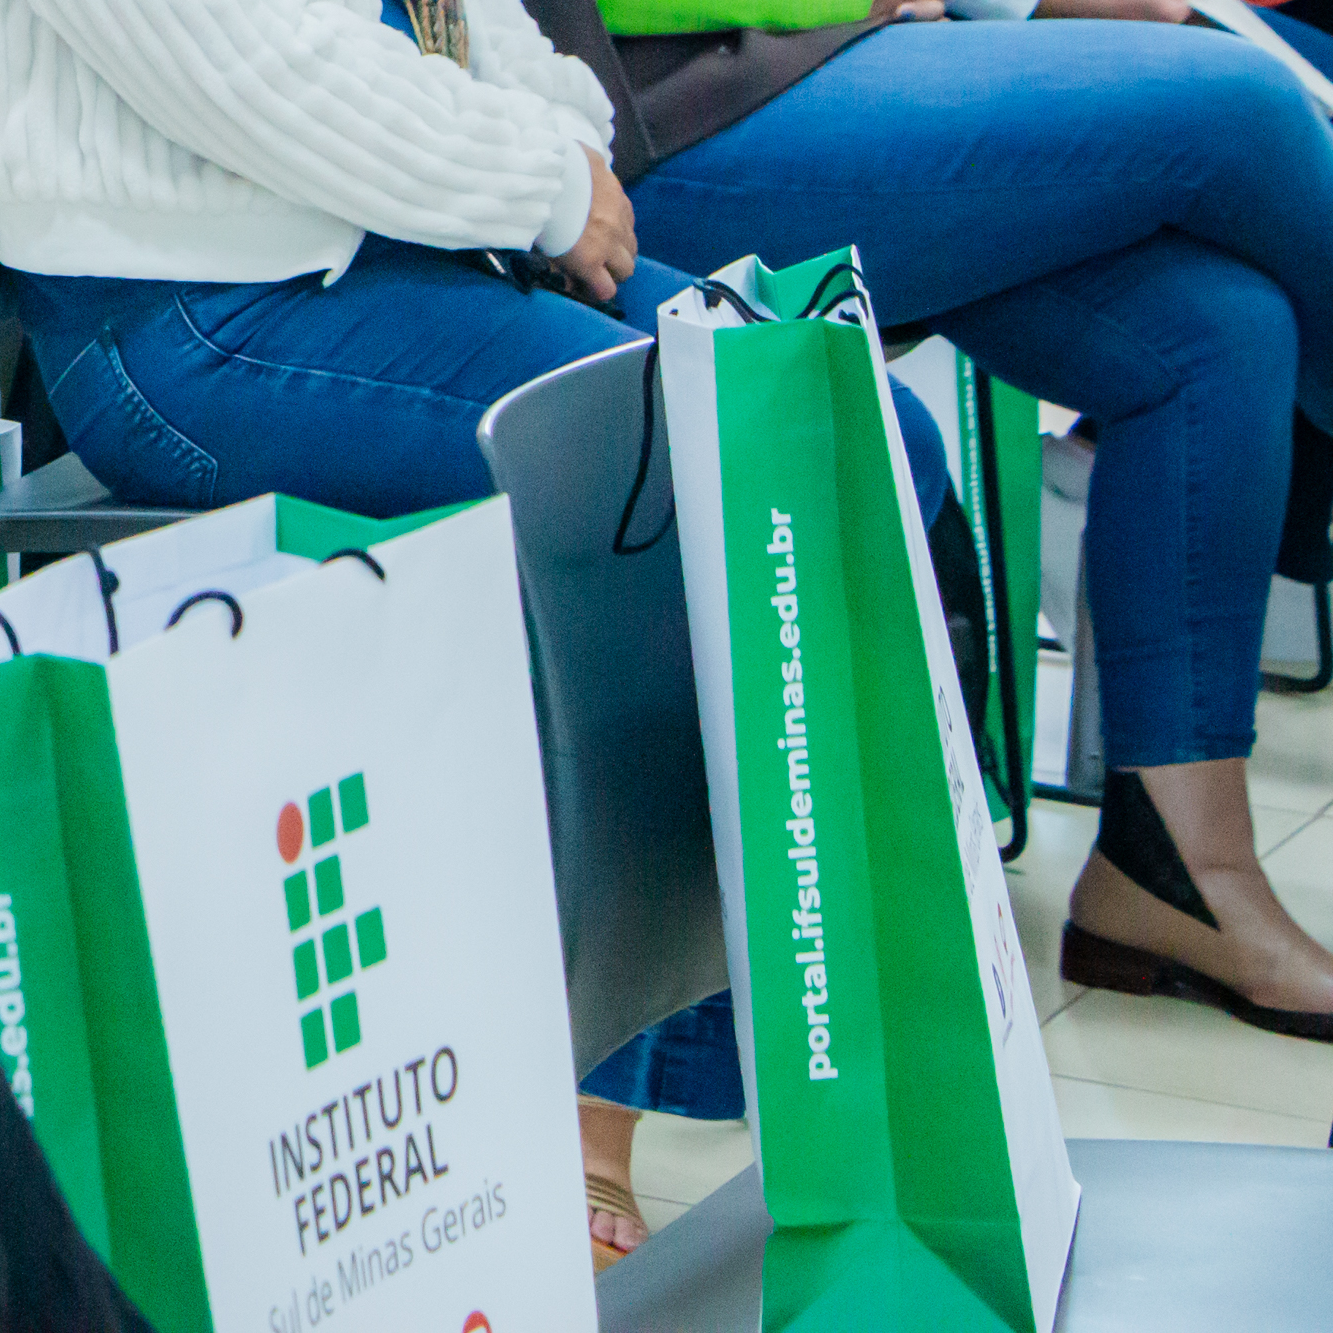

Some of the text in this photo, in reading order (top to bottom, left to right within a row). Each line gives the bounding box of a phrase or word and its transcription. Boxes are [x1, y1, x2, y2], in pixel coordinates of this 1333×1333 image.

[766, 507, 839, 1081] portal.ifsuldeminas.edu.br
[269, 1044, 459, 1198] INSTITUTO
[293, 1122, 450, 1258] FEDERAL
[306, 1274, 335, 1327] de
[337, 1231, 415, 1304] Minas
[421, 1178, 508, 1254] Gerais
